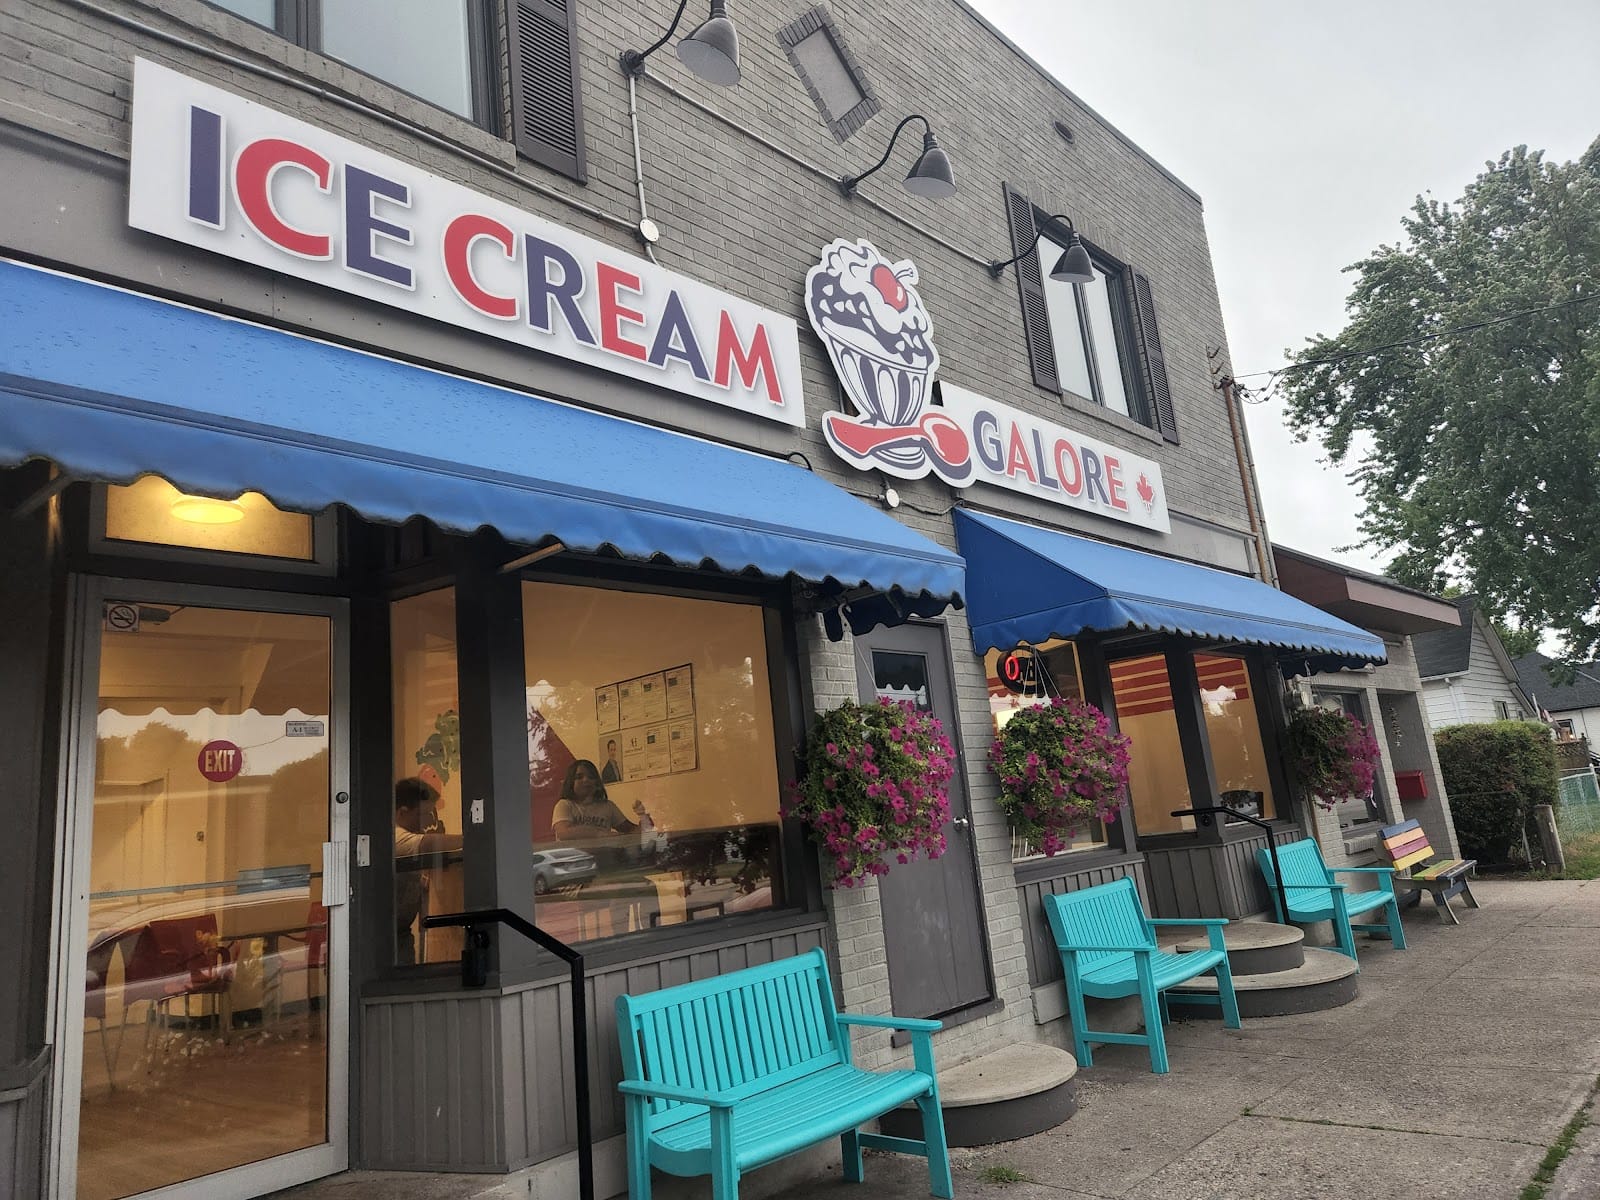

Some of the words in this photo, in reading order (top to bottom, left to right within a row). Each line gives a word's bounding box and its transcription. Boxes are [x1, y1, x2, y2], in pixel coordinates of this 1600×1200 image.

[188, 104, 413, 288] ICE
[443, 213, 783, 404] CREAM
[972, 410, 1128, 512] GALORE
[205, 750, 236, 772] EXIT
